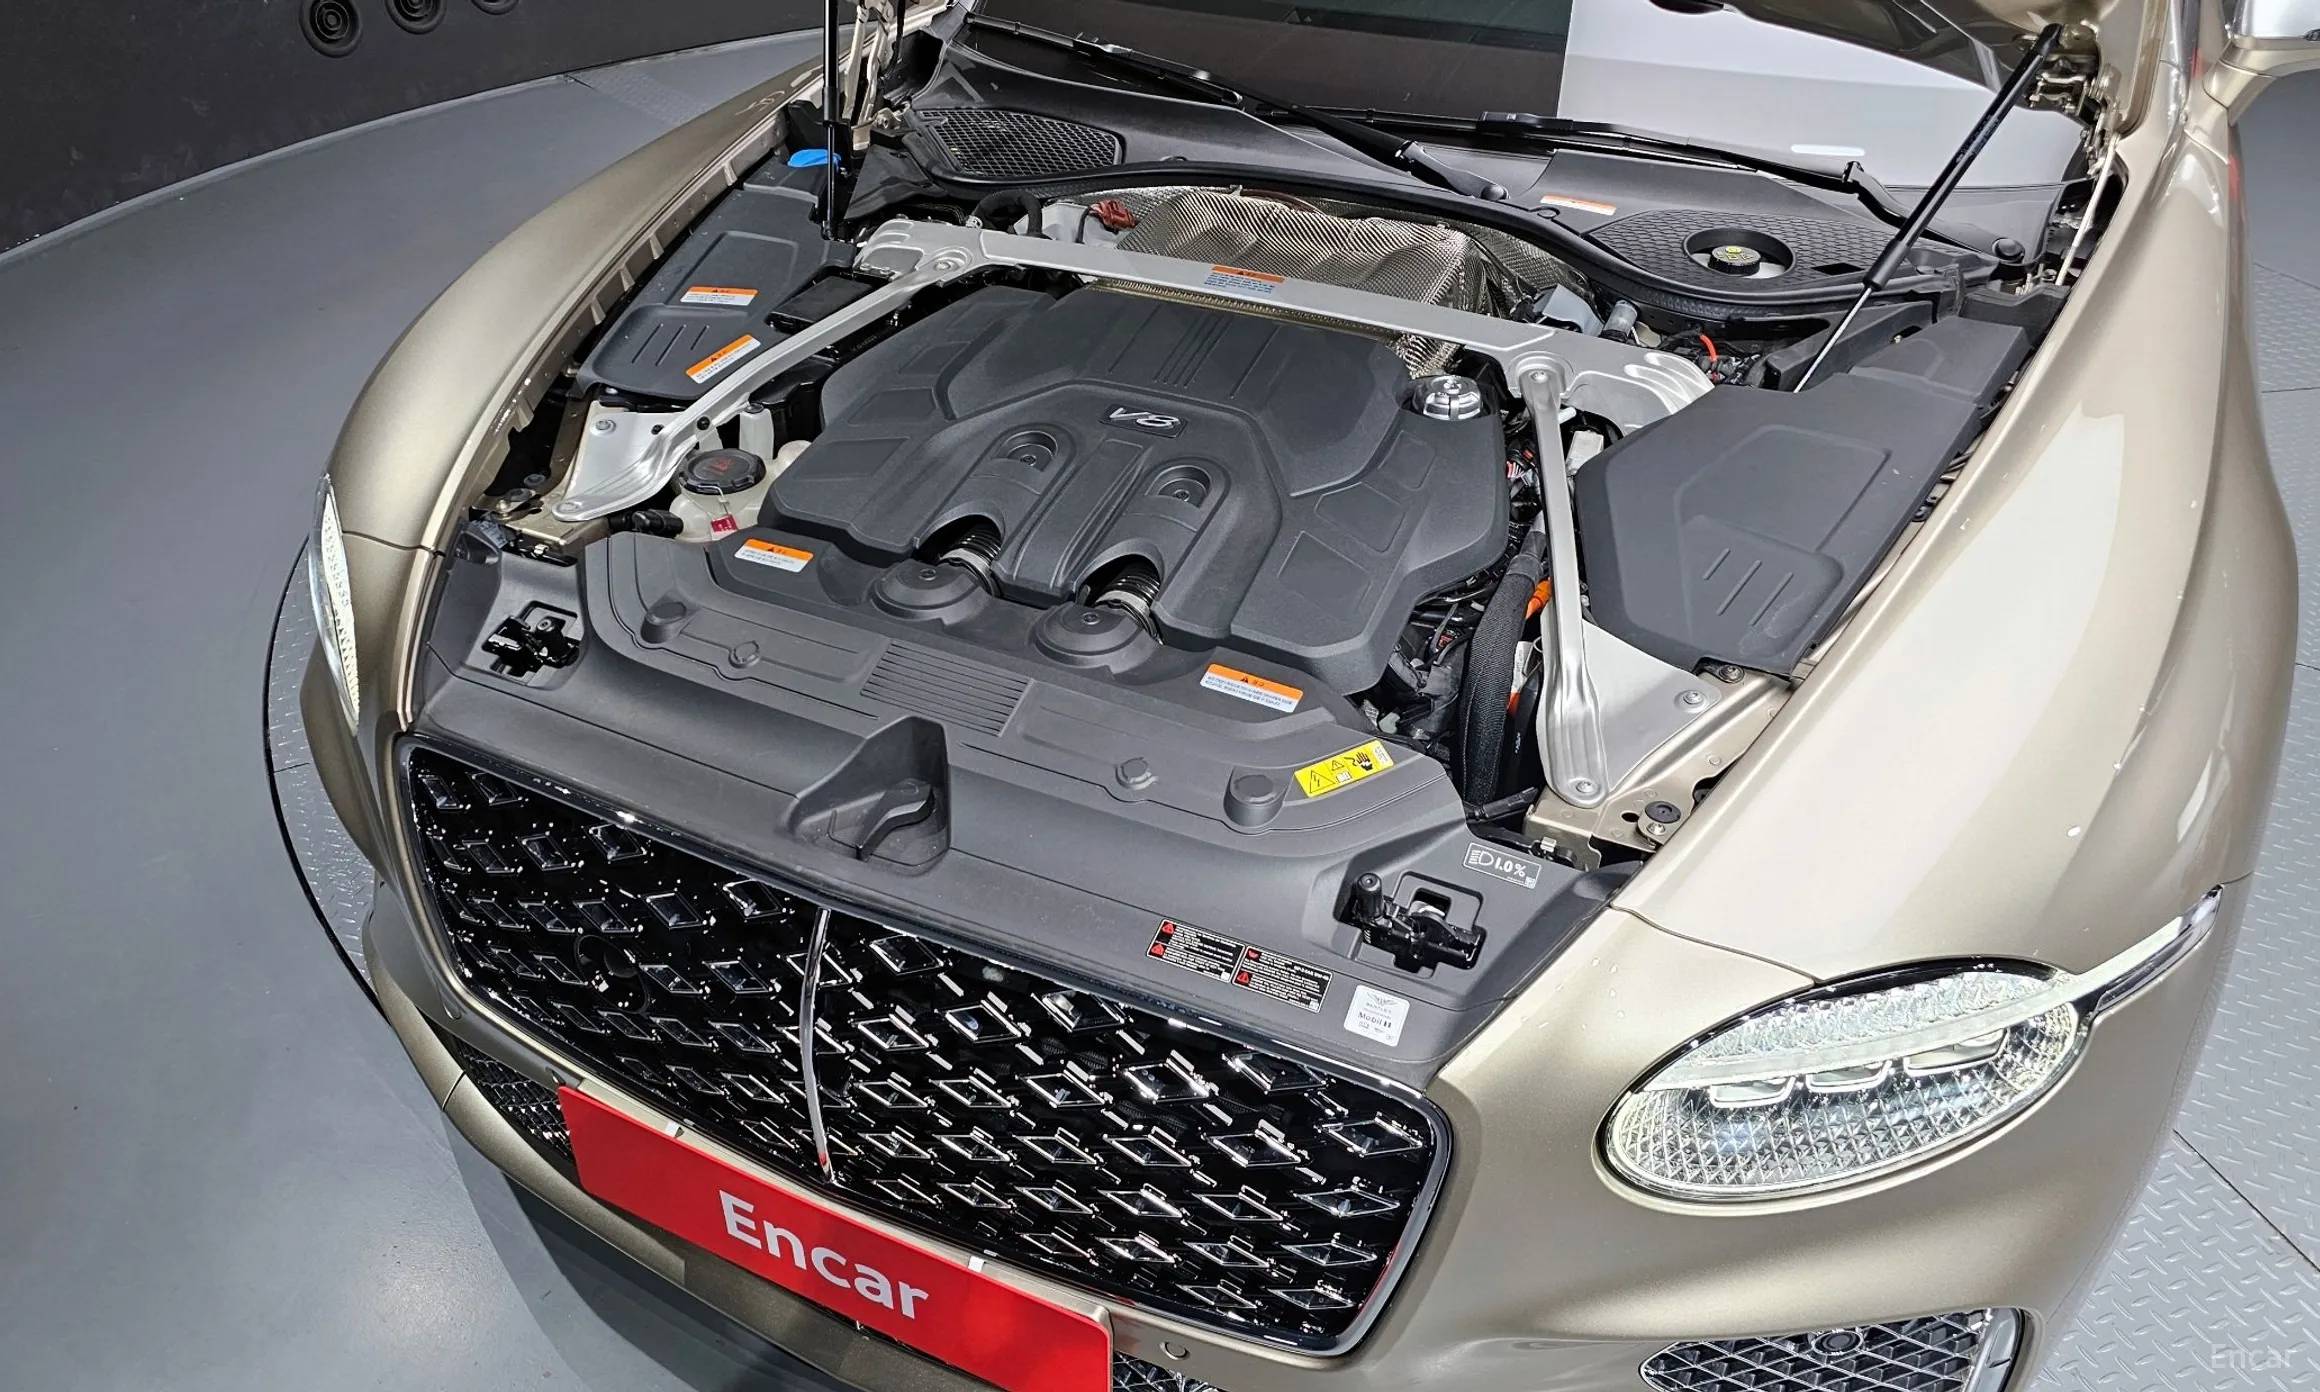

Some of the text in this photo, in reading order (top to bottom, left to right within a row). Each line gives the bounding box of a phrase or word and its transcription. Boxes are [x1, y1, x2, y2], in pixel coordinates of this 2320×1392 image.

[1109, 407, 1181, 429] V8
[1494, 856, 1527, 877] 1.0%
[1357, 1011, 1383, 1026] Mobil
[718, 1189, 930, 1319] Encar
